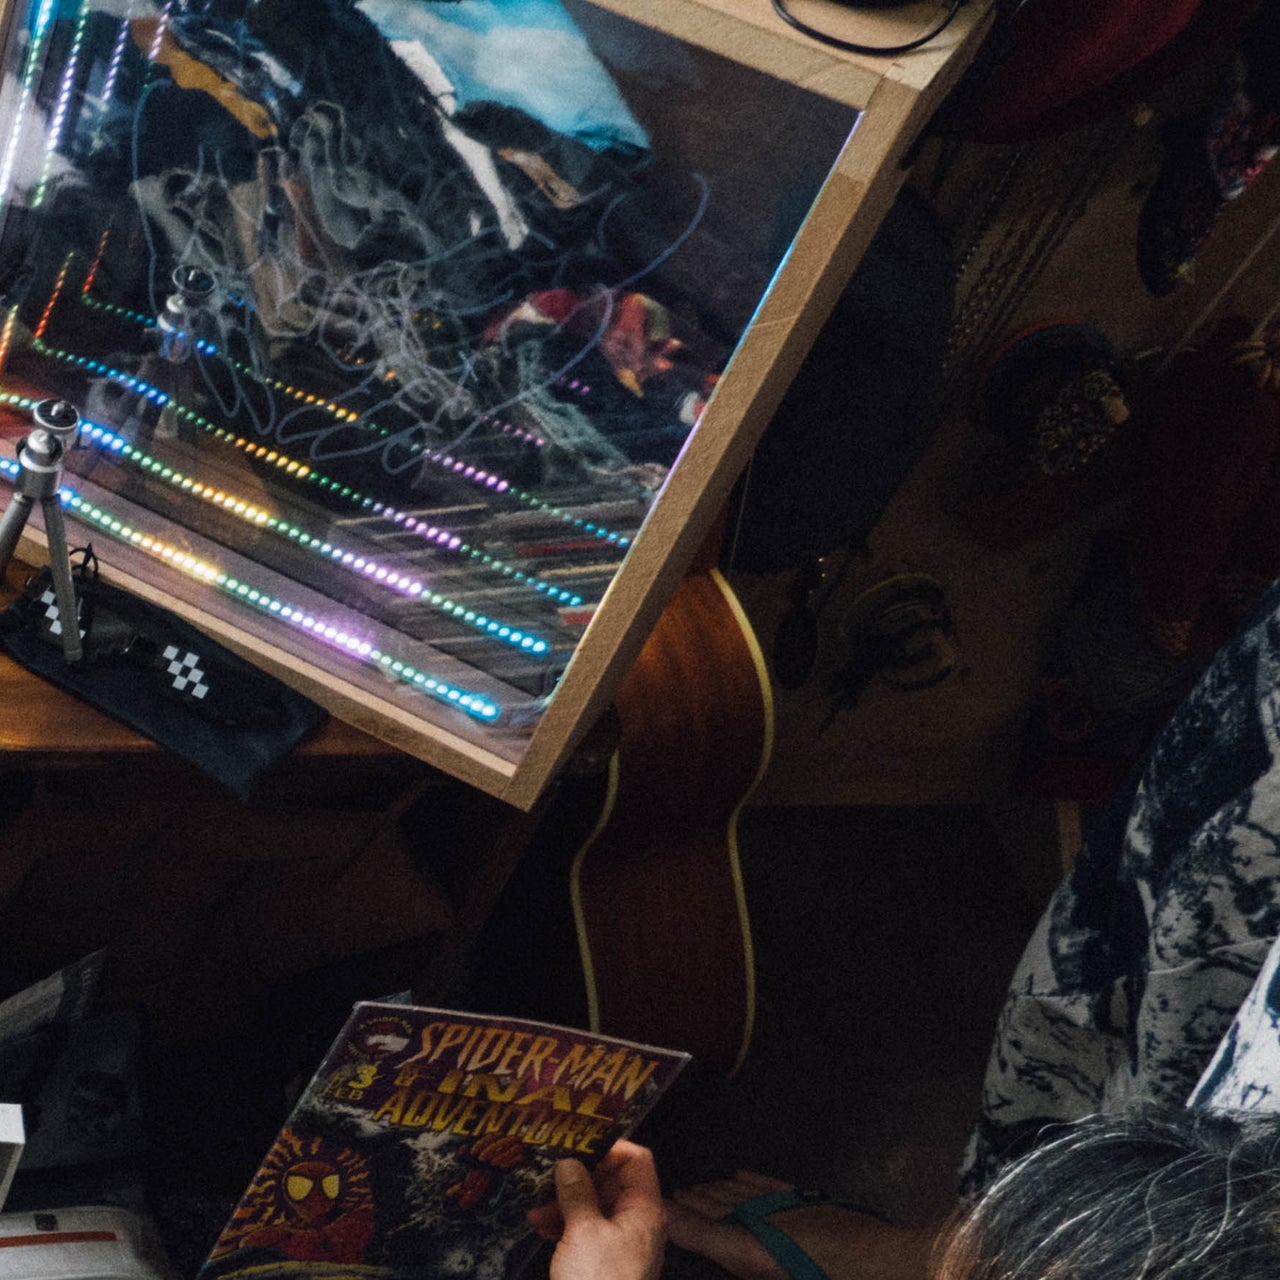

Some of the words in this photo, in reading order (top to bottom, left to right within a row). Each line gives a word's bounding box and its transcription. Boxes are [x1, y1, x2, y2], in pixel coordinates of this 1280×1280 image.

[348, 1063, 378, 1089] 3
[394, 1022, 659, 1101] SPIDER-MAN
[322, 1087, 364, 1101] FEB
[371, 1087, 612, 1154] ADVENTURE
